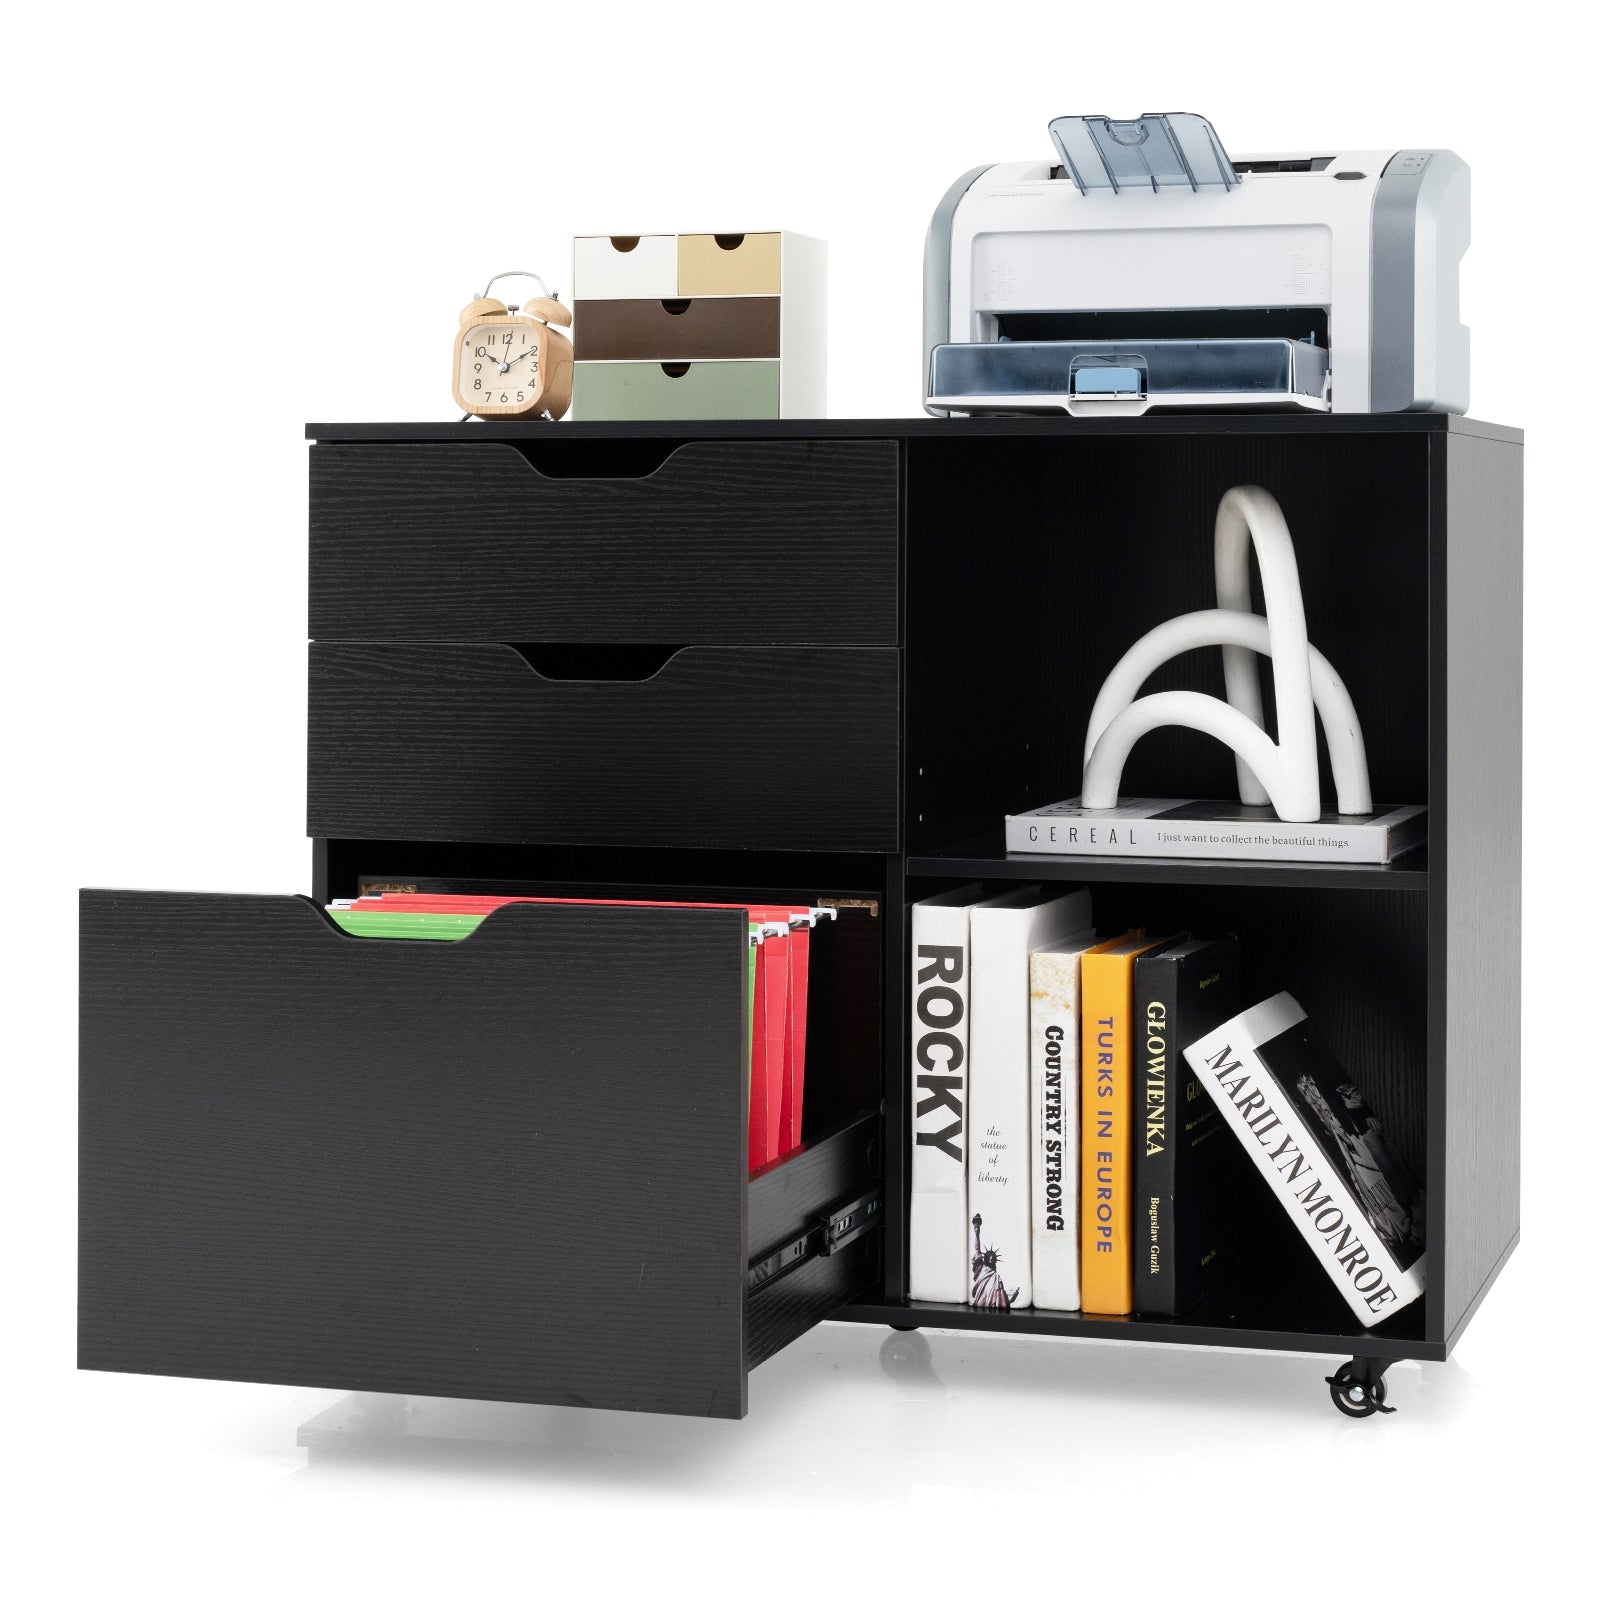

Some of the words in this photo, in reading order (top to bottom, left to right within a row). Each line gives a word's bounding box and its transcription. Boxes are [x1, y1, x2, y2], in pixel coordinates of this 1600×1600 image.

[487, 334, 495, 345] 11
[502, 333, 513, 345] 12
[474, 346, 487, 358] 10
[530, 345, 538, 357] 2
[474, 363, 482, 374] 9
[530, 361, 538, 372] 3
[473, 378, 482, 390] 8
[528, 377, 536, 388] 4
[484, 391, 492, 403] 7
[500, 392, 508, 403] 6
[516, 391, 524, 402] 5
[1029, 826, 1137, 845] CEREAL
[1162, 832, 1182, 843] just
[1184, 834, 1207, 843] want
[1209, 834, 1219, 843] to
[1221, 834, 1252, 844] collect
[1254, 835, 1270, 845] the
[1272, 835, 1316, 846] beautiful
[1318, 837, 1349, 849] things
[916, 944, 964, 1164] ROCKY
[1097, 1016, 1113, 1098] TURKS
[1045, 1025, 1064, 1135] COUNTRY
[1097, 1110, 1113, 1138] IN
[986, 1125, 1001, 1136] the
[980, 1141, 1008, 1150] statue
[988, 1154, 999, 1167] of
[978, 1171, 1009, 1187] liberty
[1046, 1139, 1064, 1231] STRONG
[1204, 1044, 1313, 1184] MARILYN
[1293, 1177, 1398, 1314] MONROE
[1096, 1151, 1113, 1253] EUROPE
[1150, 1245, 1160, 1275] Guzik
